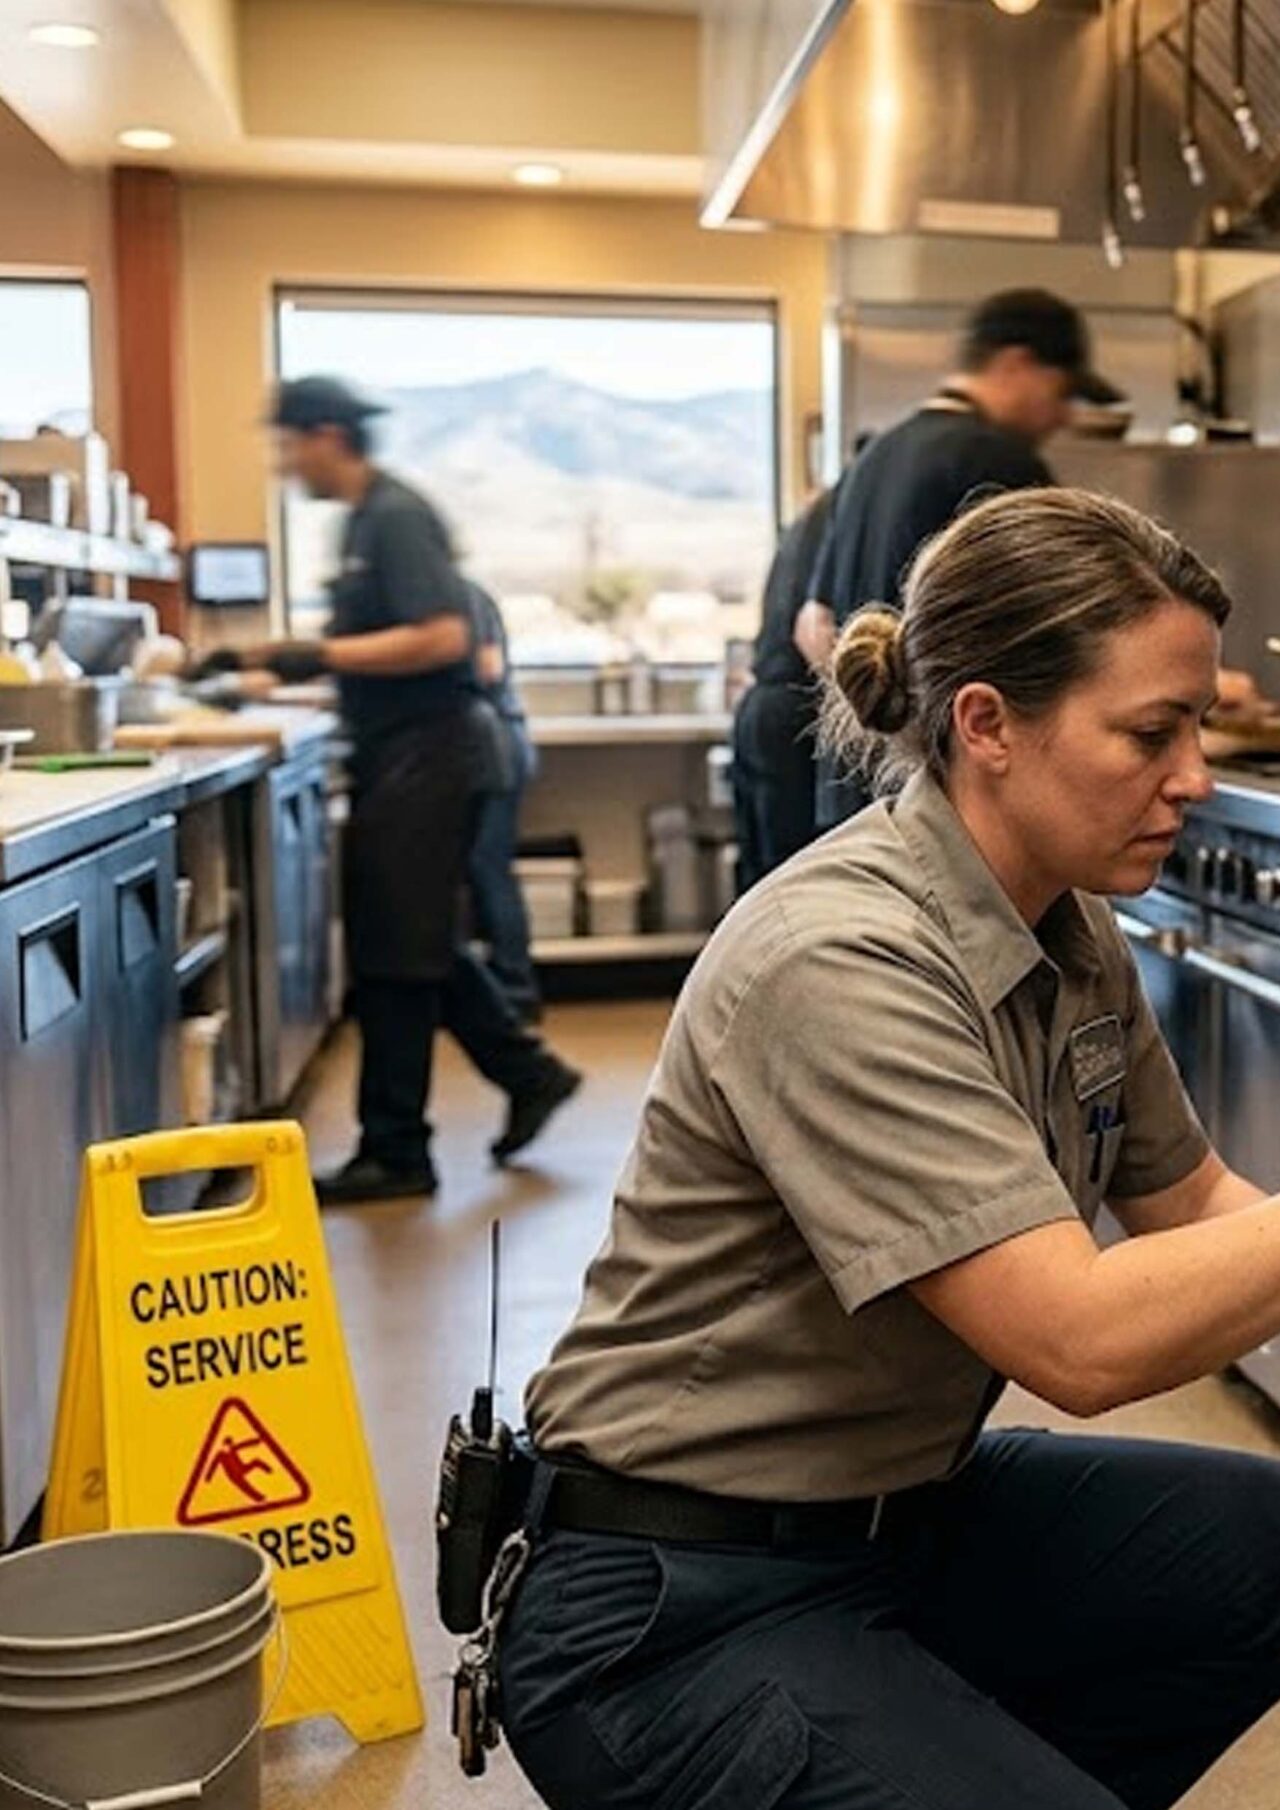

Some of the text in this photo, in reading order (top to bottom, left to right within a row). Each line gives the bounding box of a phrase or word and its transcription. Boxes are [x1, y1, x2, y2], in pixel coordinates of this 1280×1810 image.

[130, 1260, 307, 1323] CAUTION:
[145, 1323, 307, 1388] SERVICE
[239, 1513, 356, 1570] RESS
